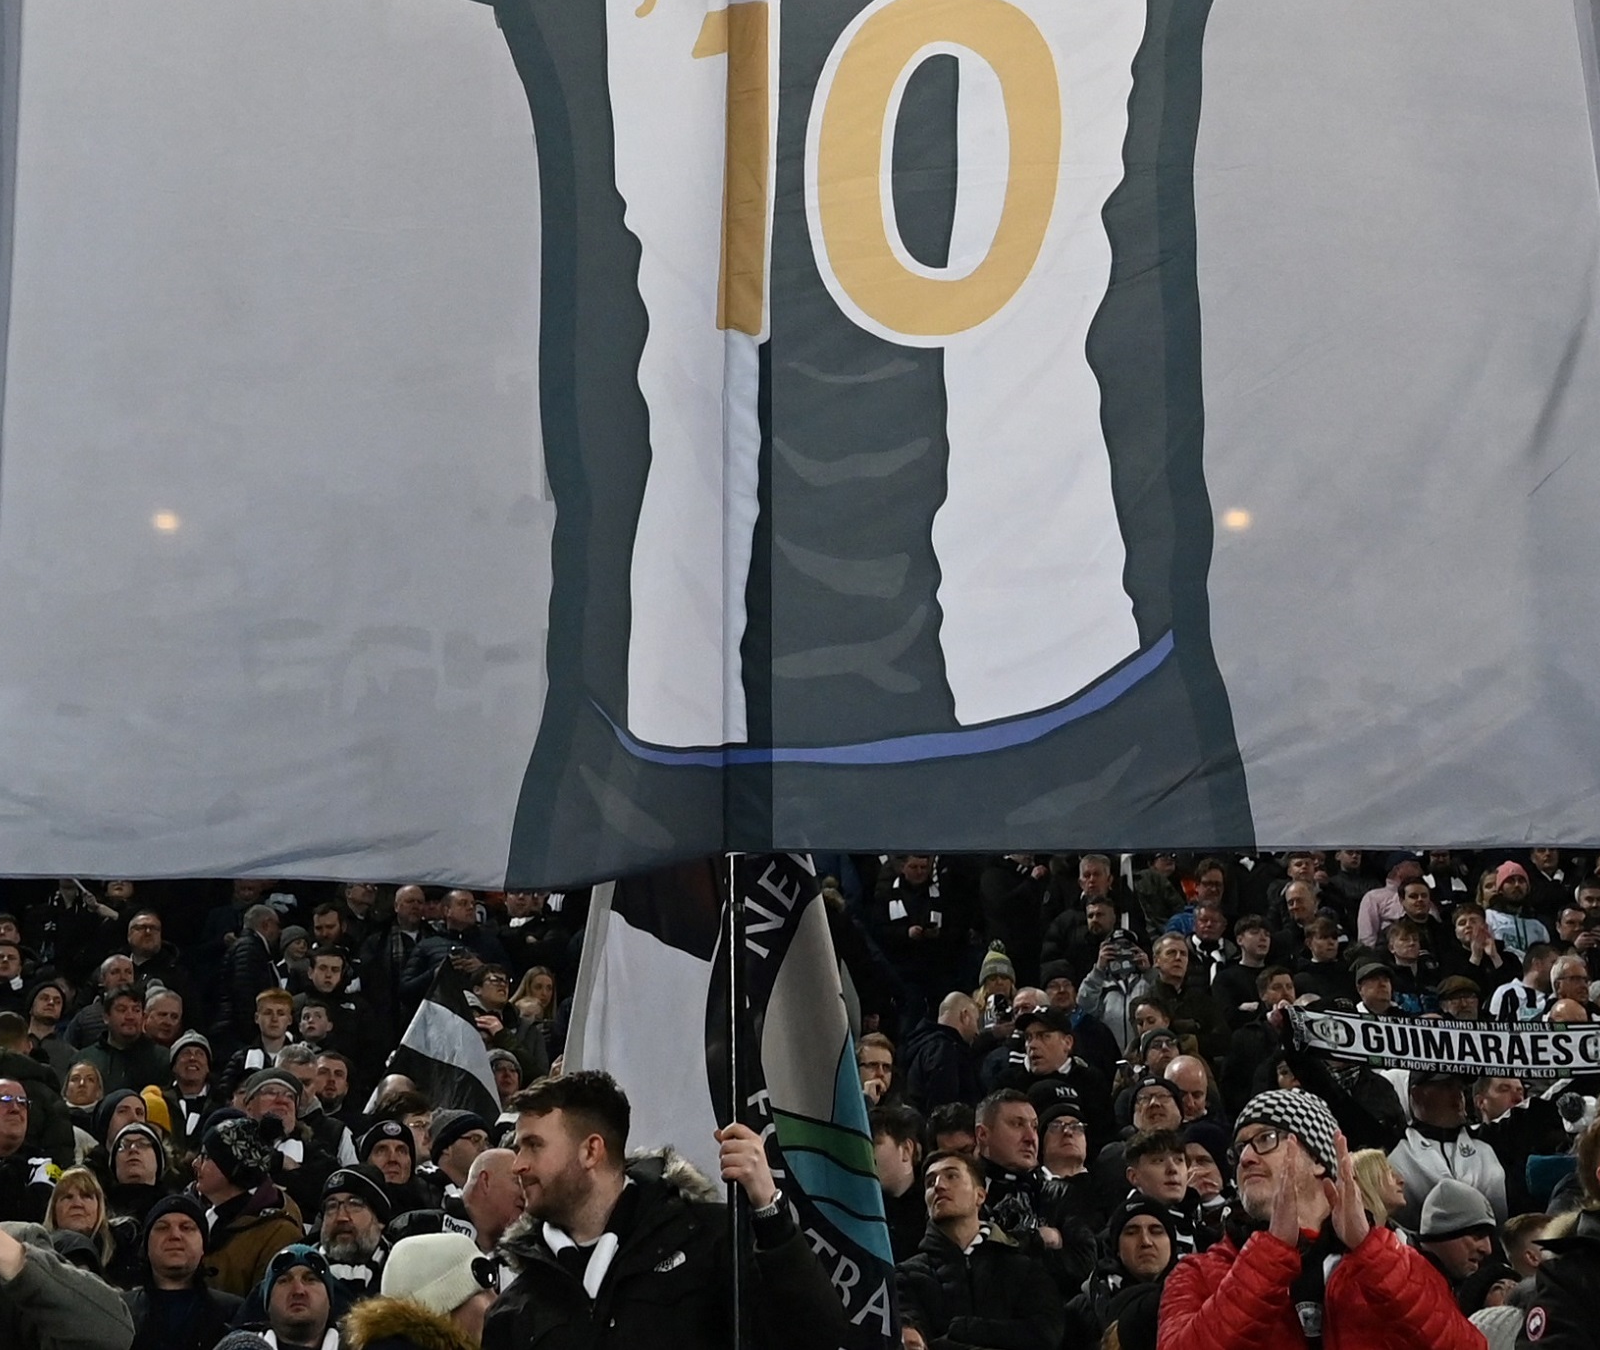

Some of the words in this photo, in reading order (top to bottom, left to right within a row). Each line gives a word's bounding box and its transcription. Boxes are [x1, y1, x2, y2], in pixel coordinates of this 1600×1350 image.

[1377, 1015, 1412, 1026] WE'VE
[1414, 1017, 1435, 1028] GOT
[1437, 1019, 1474, 1030] BRUNO
[1476, 1021, 1488, 1031] IN
[1489, 1021, 1511, 1031] THE
[1513, 1022, 1552, 1032] MIDDLE
[1384, 1057, 1398, 1067] HE
[1400, 1060, 1436, 1071] KNOWS
[1439, 1063, 1483, 1076] EXACTLY
[1484, 1067, 1511, 1076] WHAT
[1513, 1068, 1528, 1078] WE
[1530, 1068, 1557, 1078] NEED
